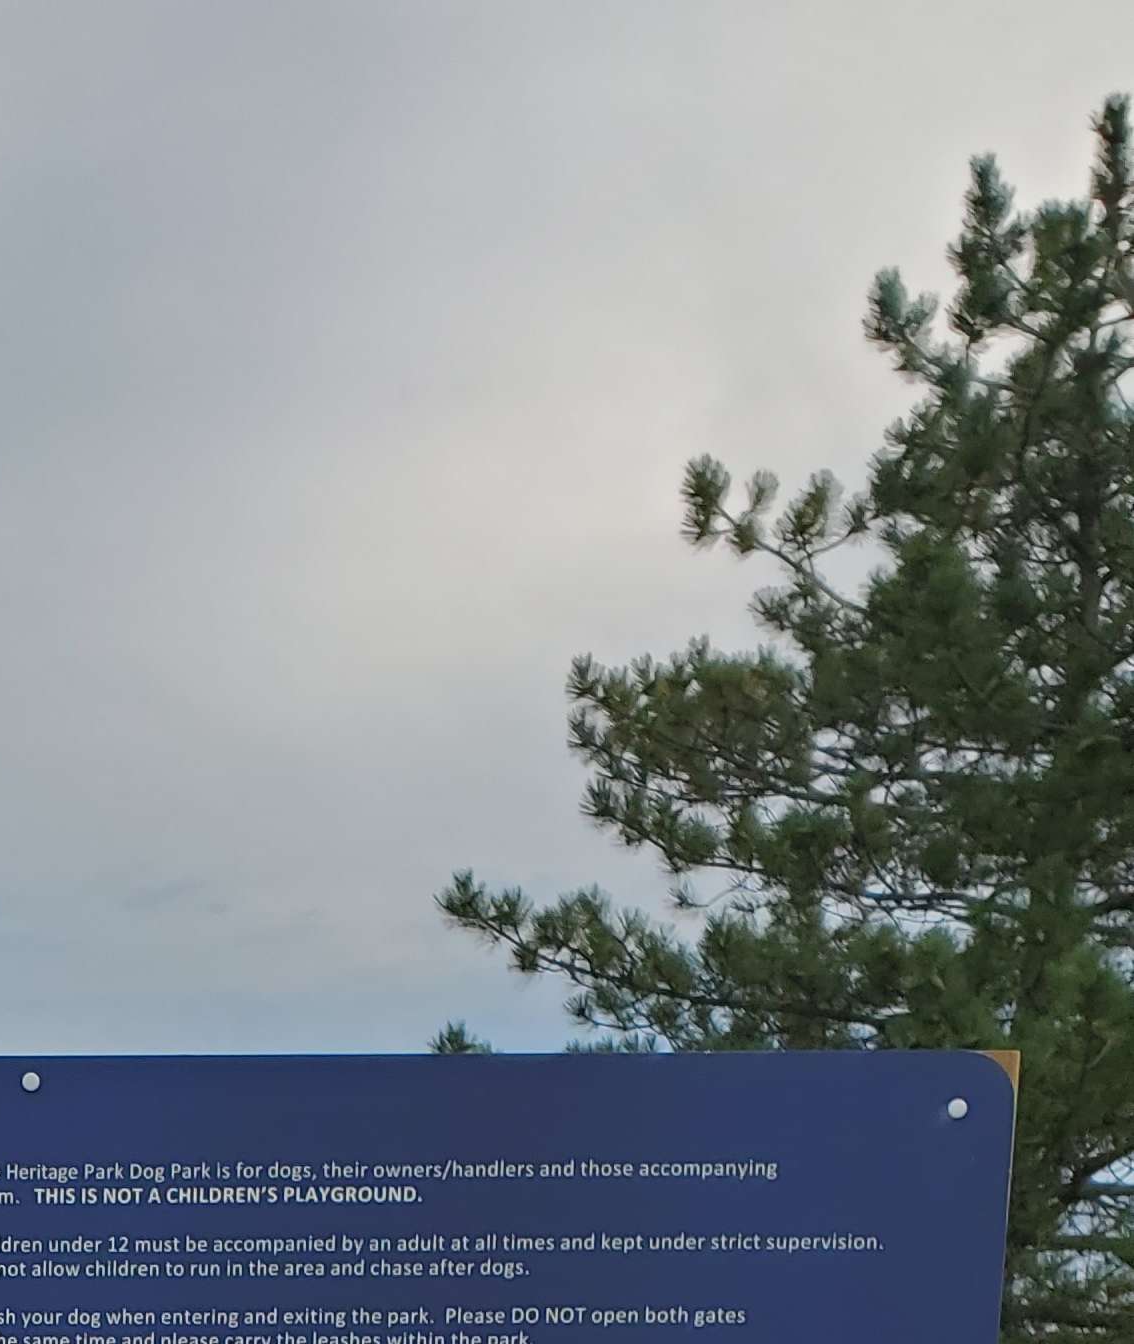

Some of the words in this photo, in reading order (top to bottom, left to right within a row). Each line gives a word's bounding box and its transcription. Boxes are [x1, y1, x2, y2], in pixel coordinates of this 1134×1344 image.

[7, 1164, 78, 1183] Heritage
[85, 1163, 123, 1179] Park
[130, 1164, 164, 1183] Dog
[171, 1162, 210, 1179] Park
[217, 1162, 230, 1179] is
[237, 1162, 263, 1178] for
[268, 1162, 316, 1181] dogs,
[323, 1161, 368, 1178] their
[374, 1160, 534, 1180] owners/handlers
[540, 1160, 574, 1177] and
[581, 1160, 633, 1176] those
[639, 1160, 777, 1179] accompanying
[34, 1188, 75, 1204] THIS
[82, 1188, 97, 1204] IS
[104, 1188, 143, 1204] NOT
[148, 1188, 161, 1203] A
[284, 1186, 422, 1202] PLAYGROUND.
